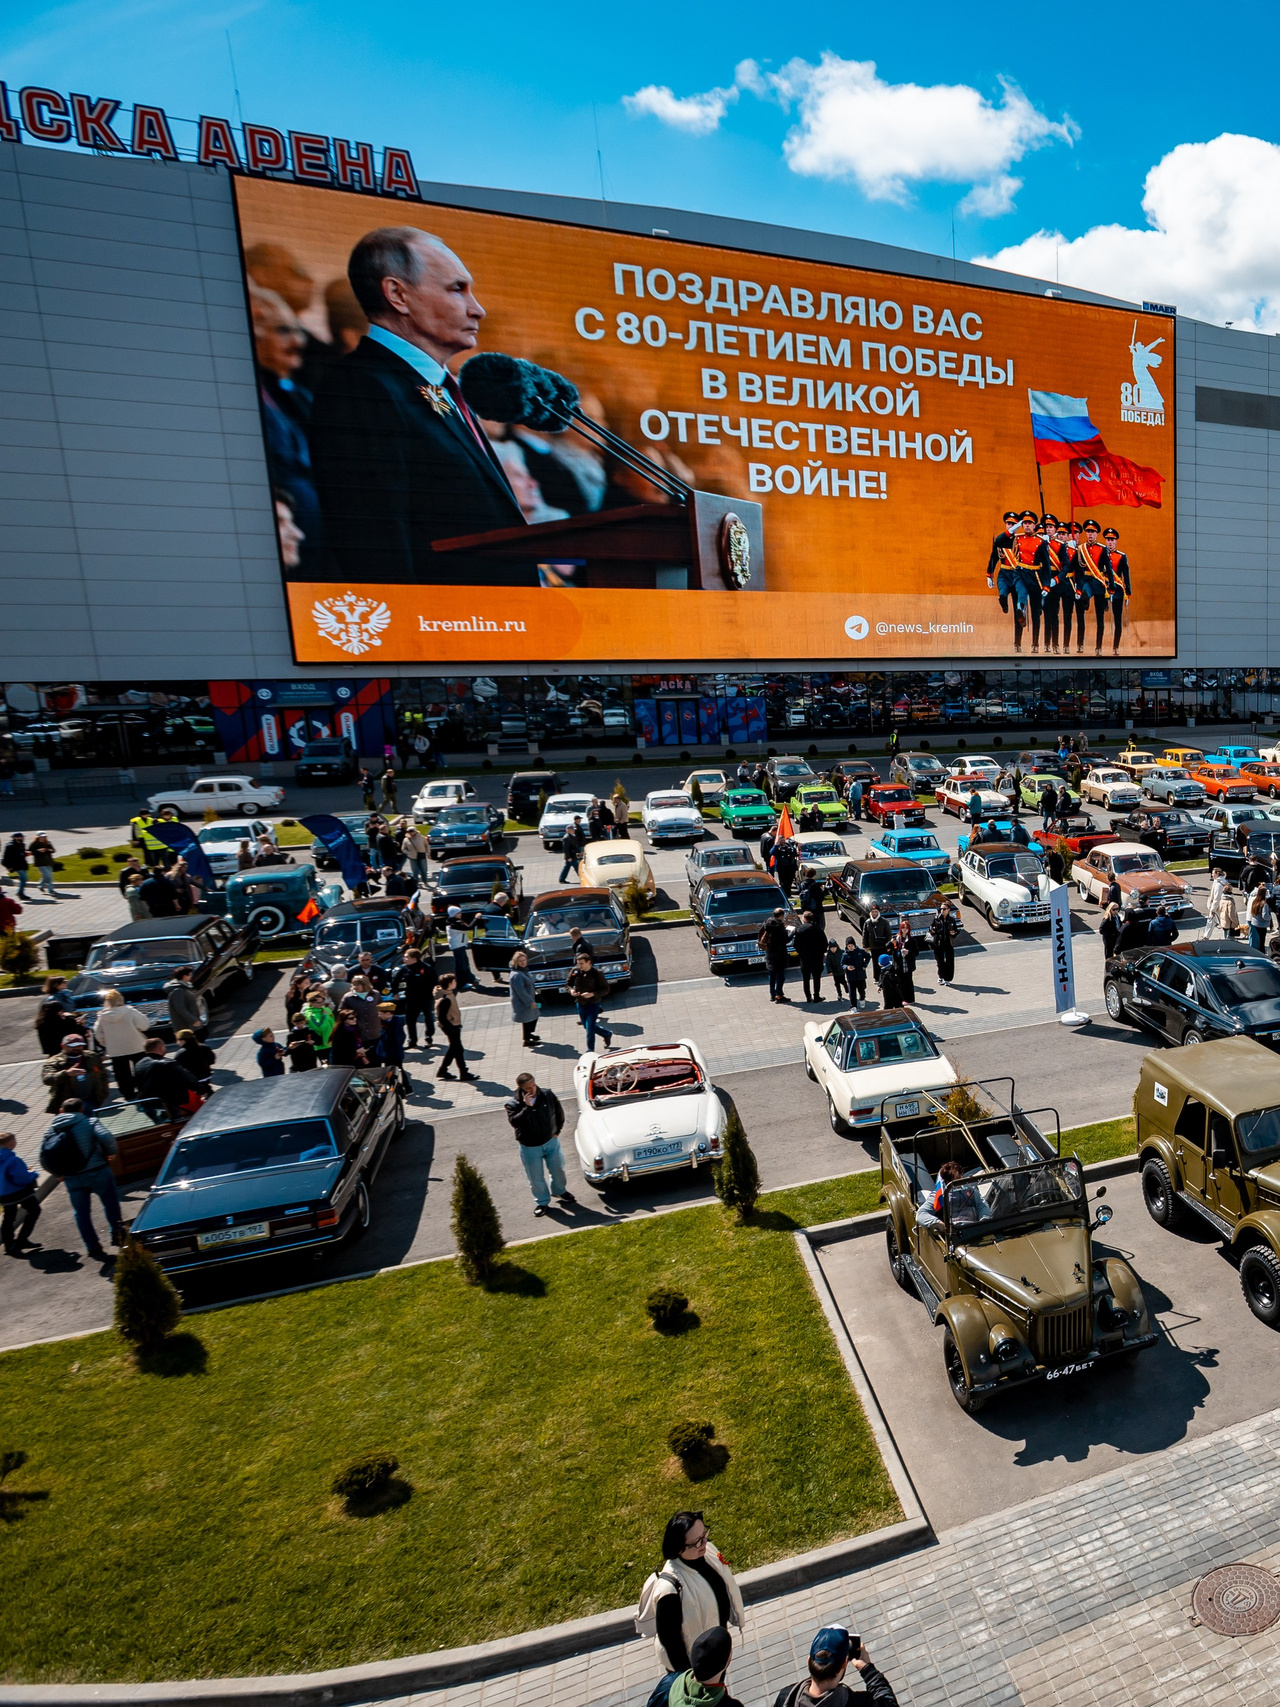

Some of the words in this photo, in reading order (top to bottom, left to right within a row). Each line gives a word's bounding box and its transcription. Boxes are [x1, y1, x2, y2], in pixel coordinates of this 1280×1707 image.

[198, 114, 422, 199] АРЕНА
[613, 262, 903, 332] ПОЗДРАВЛЯЮ
[913, 304, 983, 341] ВАС
[1150, 304, 1176, 314] MAER
[575, 307, 605, 341] С
[616, 311, 852, 369] 80-ЛЕТИЕМ
[861, 341, 1014, 389] ПОБЕДЫ
[702, 368, 727, 400] В
[738, 372, 921, 418] ВЕЛИКОЙ
[1121, 381, 1142, 406] 80
[1121, 409, 1165, 426] ПОБЕДА!
[640, 409, 974, 464] ОТЕЧЕСТВЕННОЙ
[749, 459, 888, 500] ВОЙНЕ!
[419, 614, 527, 633] kremlin.ru
[875, 619, 974, 635] @news_kremlin
[290, 683, 316, 691] ВХОД
[661, 680, 692, 690] ЦСКА
[266, 717, 275, 751] OLIMPBET
[1056, 917, 1069, 983] НАМИ
[637, 1147, 668, 1157] Р190КО
[669, 1142, 679, 1150] 177
[204, 1230, 245, 1243] А005ТВ
[248, 1224, 262, 1234] 197
